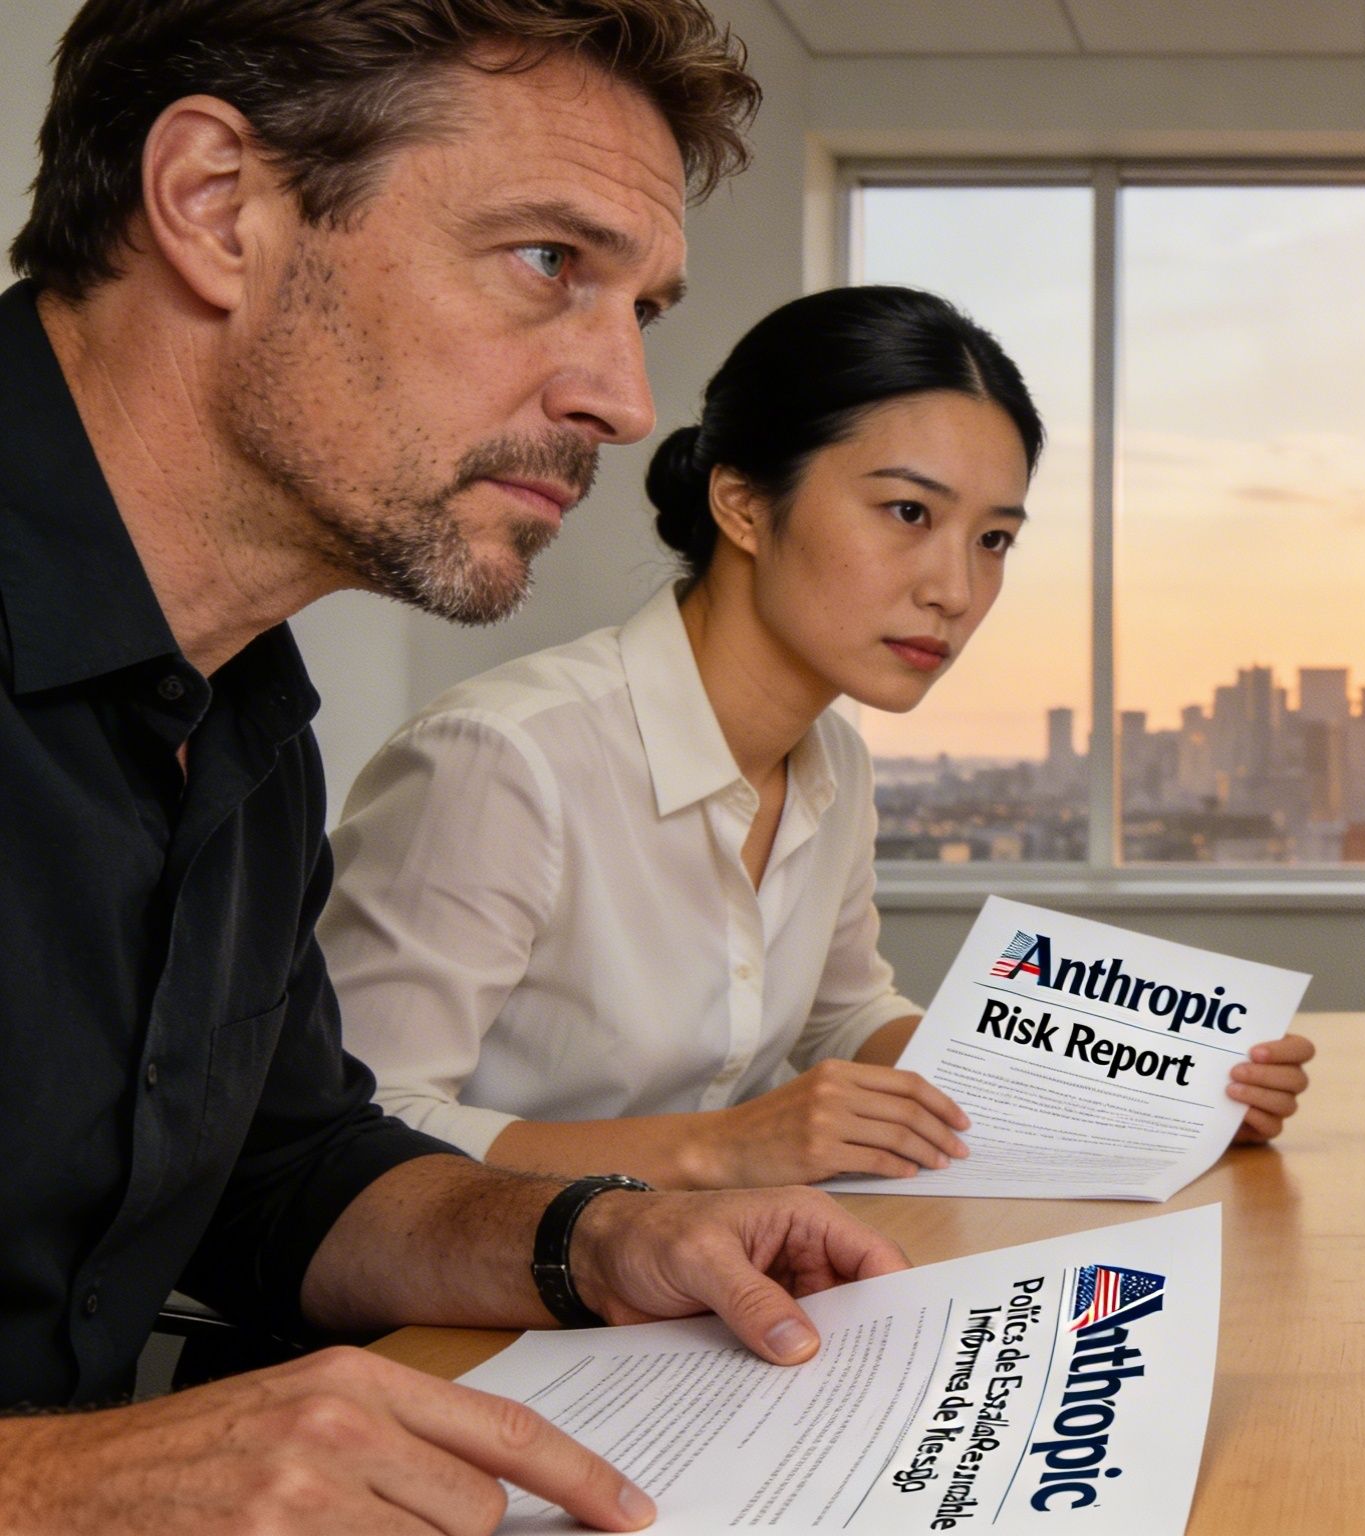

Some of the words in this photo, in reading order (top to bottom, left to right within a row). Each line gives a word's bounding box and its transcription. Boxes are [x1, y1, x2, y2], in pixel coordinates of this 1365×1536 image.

[1007, 933, 1248, 1035] Anthropic
[976, 998, 1060, 1052] Risk
[1063, 1022, 1195, 1087] Report
[994, 1347, 1030, 1374] de
[932, 1396, 973, 1423] de
